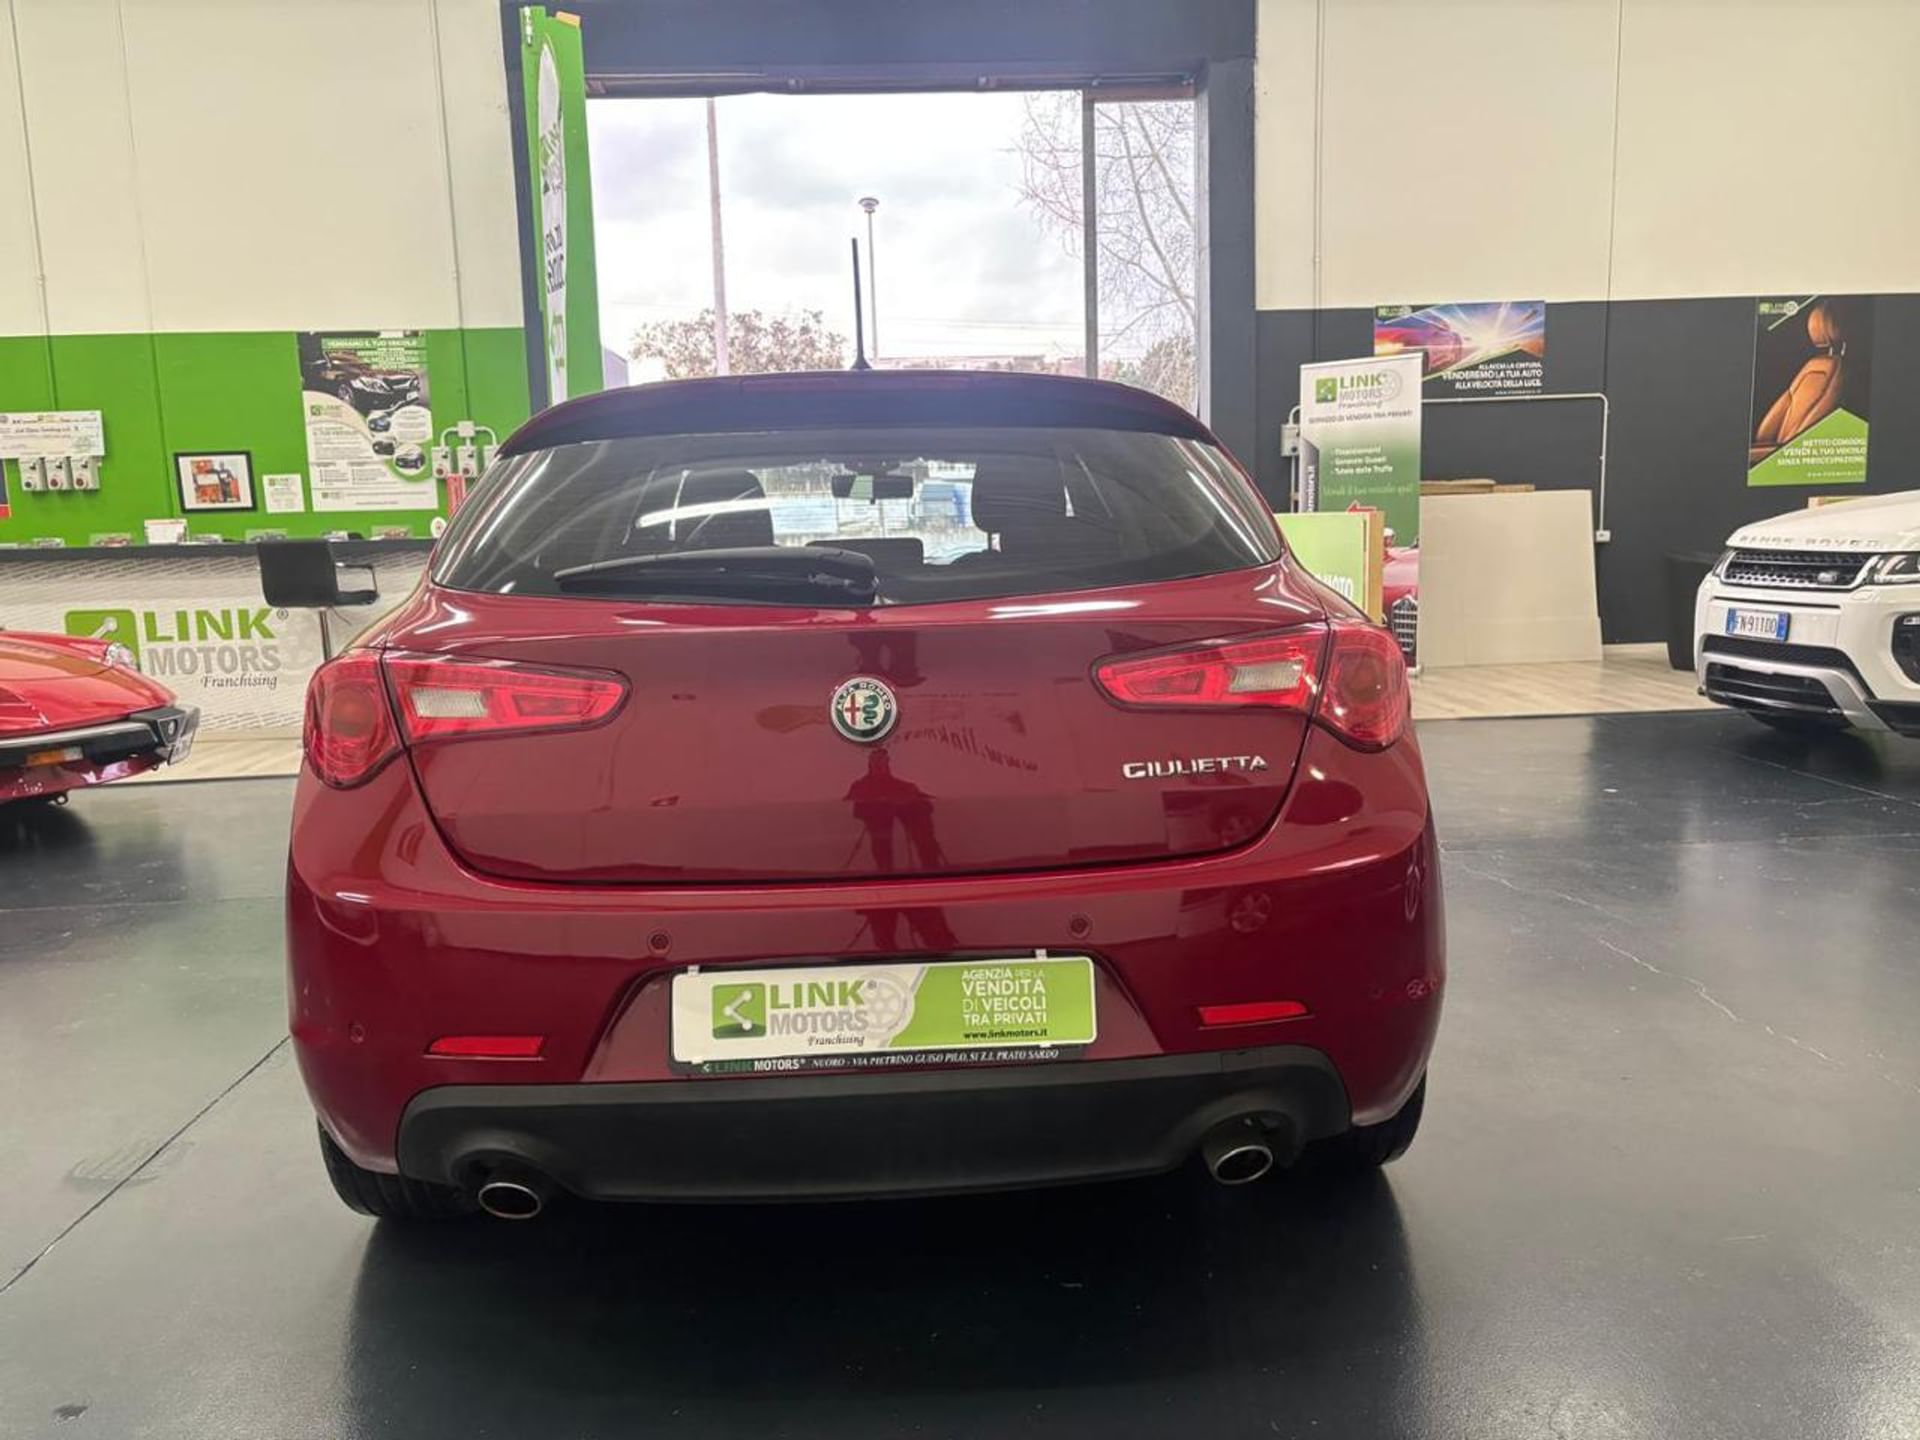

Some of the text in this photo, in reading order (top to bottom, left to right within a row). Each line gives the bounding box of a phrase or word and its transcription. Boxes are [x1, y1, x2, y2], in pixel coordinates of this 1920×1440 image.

[147, 644, 281, 676] MOTORS
[200, 673, 278, 690] Franchising
[1122, 755, 1268, 779] GIULIETTA
[961, 968, 1013, 981] AGENZIA
[961, 978, 1046, 997] VENDITA
[962, 995, 1047, 1013] DI VEICOLI
[769, 1009, 870, 1036] MOTORS
[963, 1011, 1047, 1027] TRA PRIVATI
[808, 1033, 865, 1047] Franchising
[963, 1028, 1048, 1039] www.linkmotors.it
